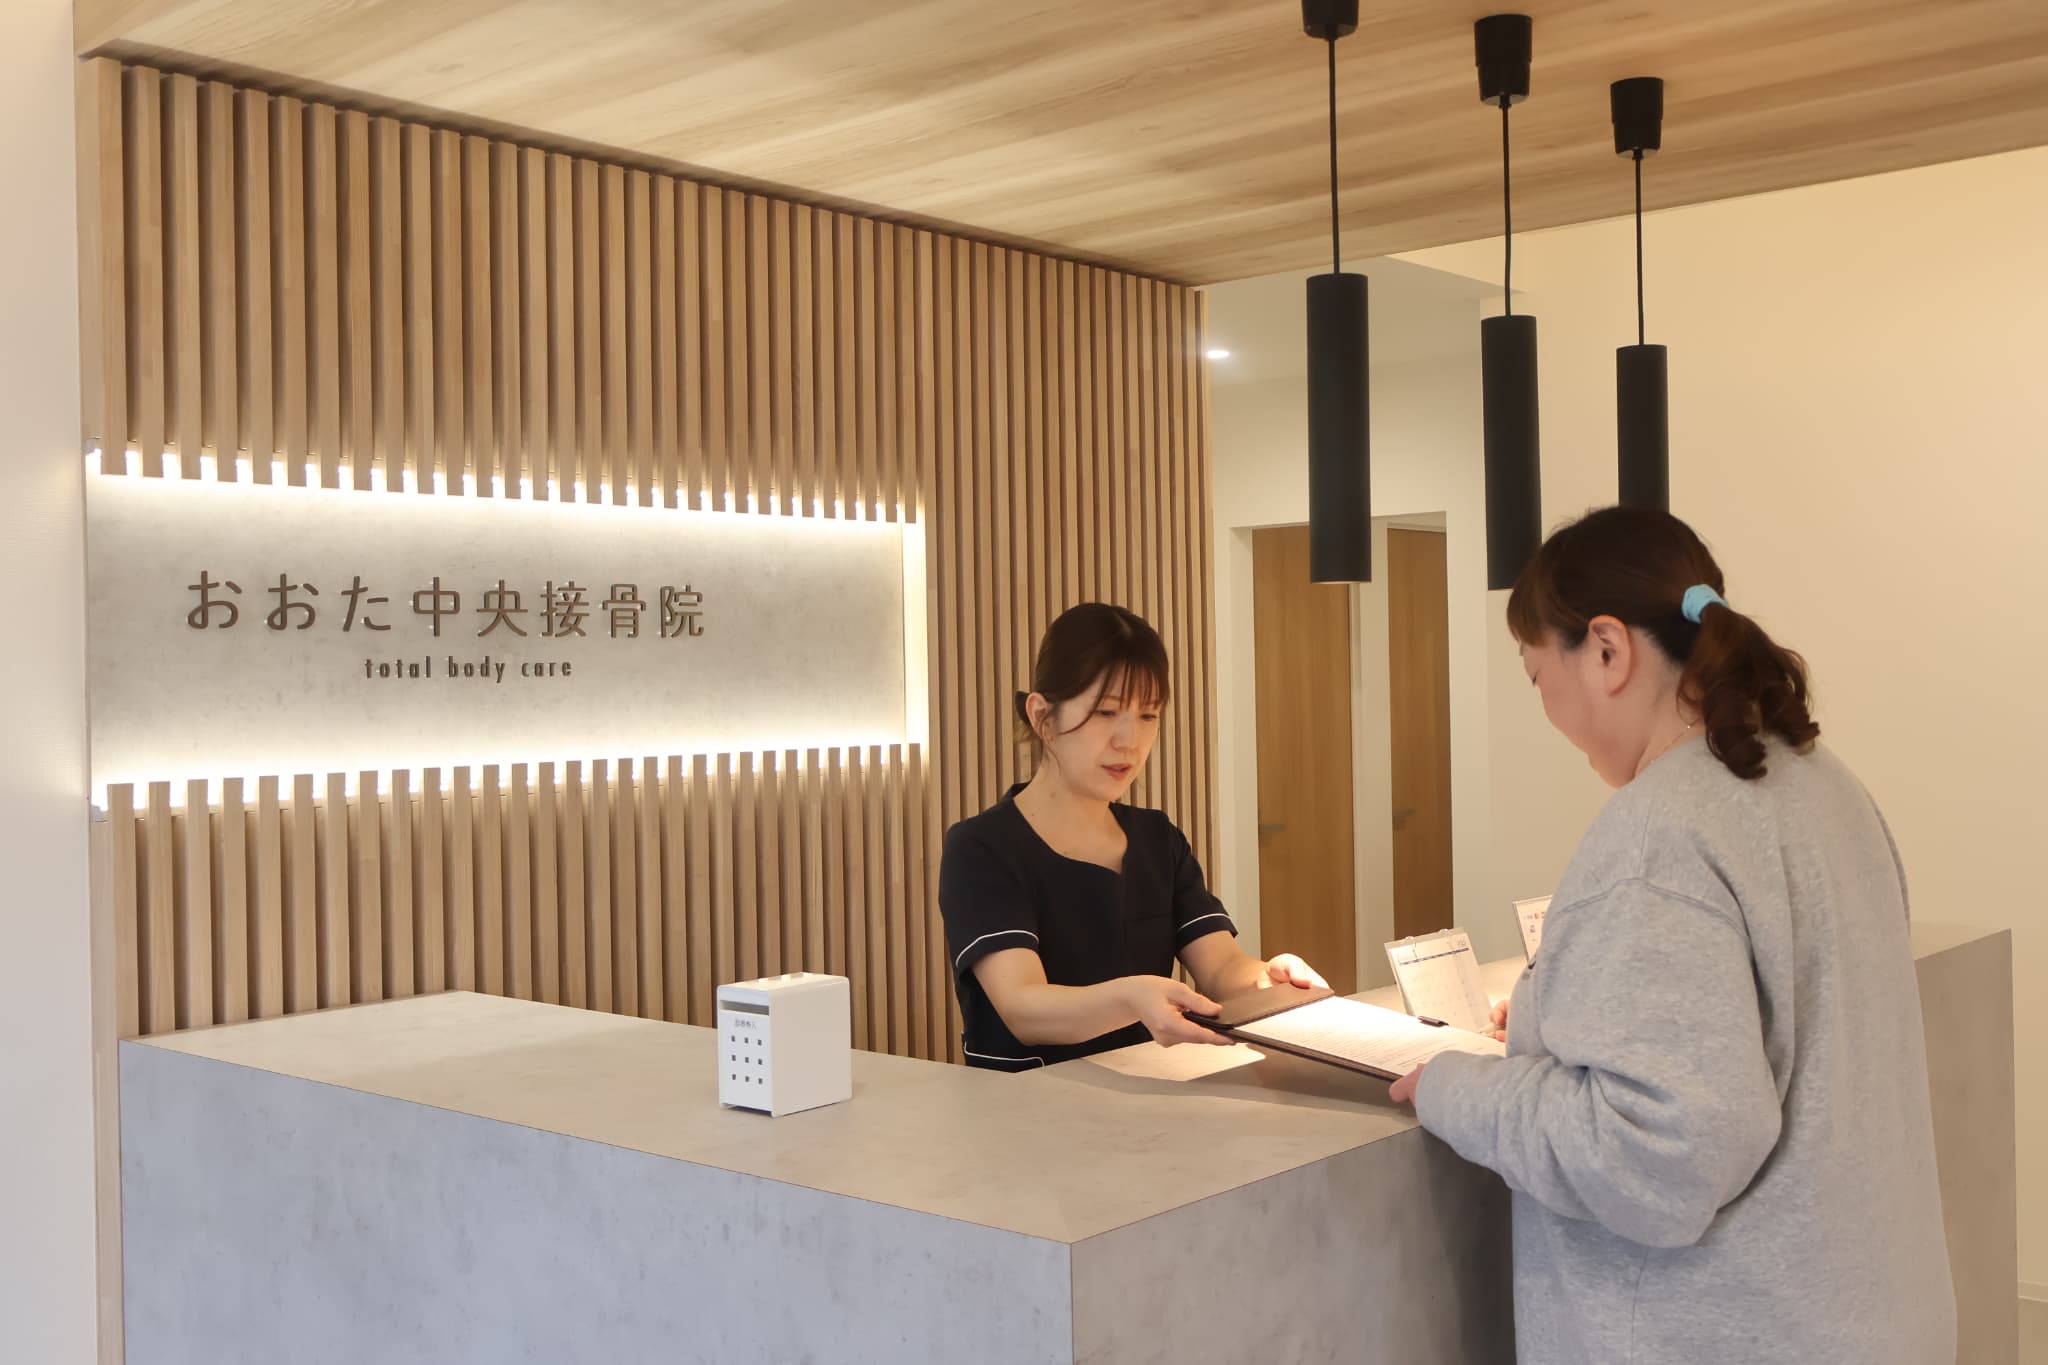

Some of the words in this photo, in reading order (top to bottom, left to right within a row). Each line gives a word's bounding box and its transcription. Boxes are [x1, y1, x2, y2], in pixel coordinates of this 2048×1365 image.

[187, 571, 705, 639] おおた中央接骨院
[365, 656, 432, 678] total
[448, 655, 505, 683] body
[521, 658, 573, 678] care
